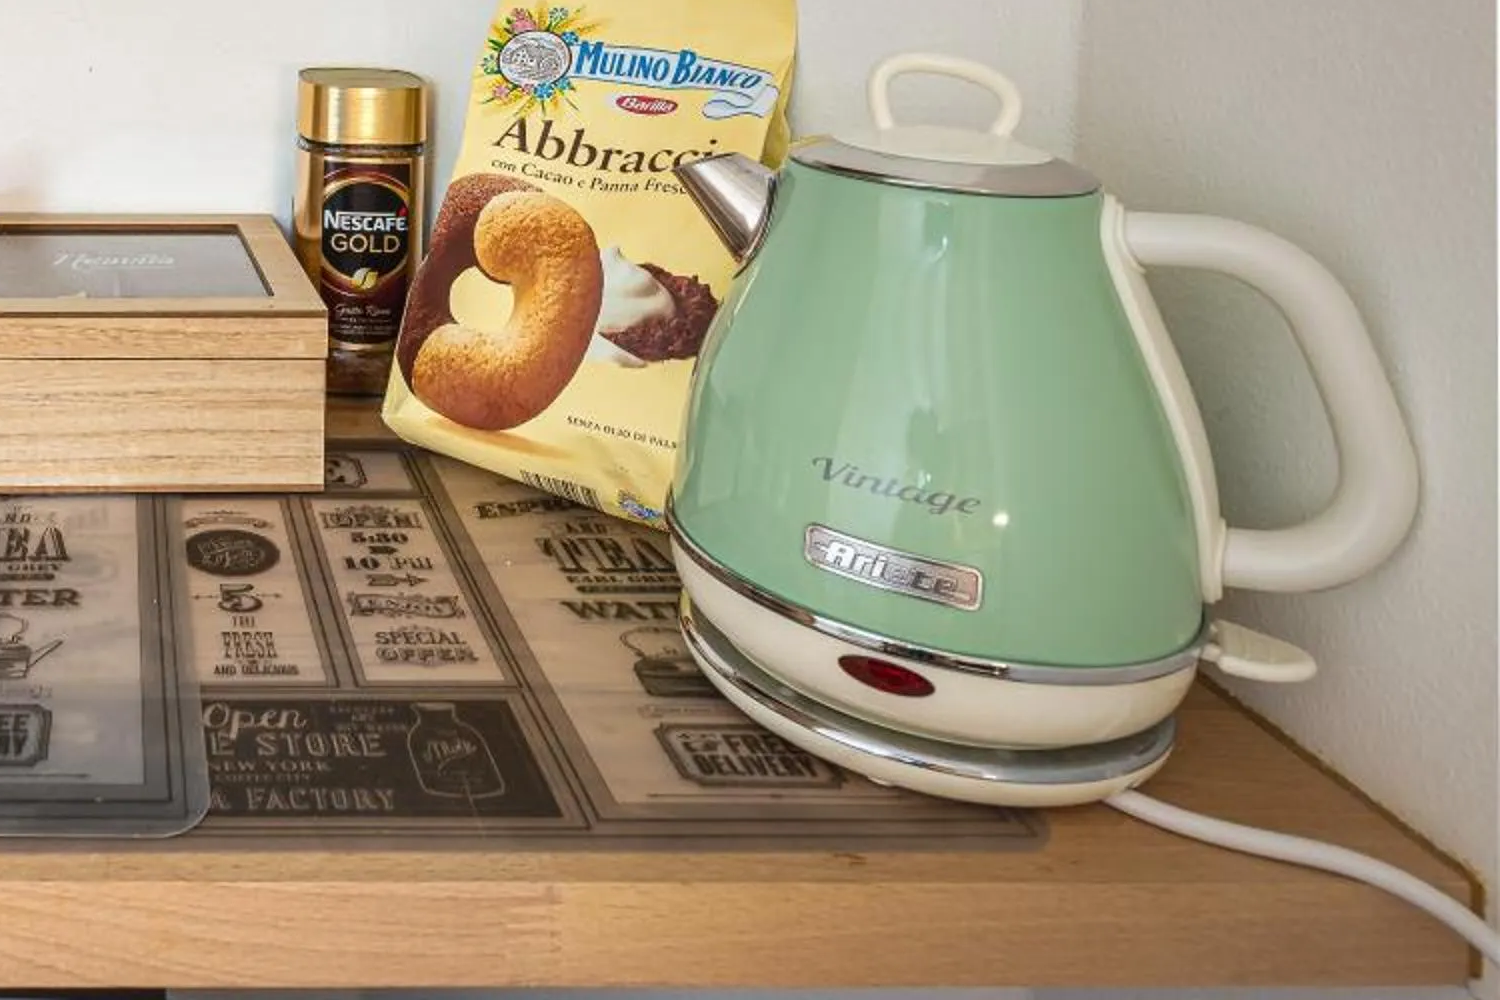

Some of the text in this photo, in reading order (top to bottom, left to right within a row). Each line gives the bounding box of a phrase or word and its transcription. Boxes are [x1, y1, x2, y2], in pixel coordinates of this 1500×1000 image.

[575, 40, 764, 89] MULINO BIANCO
[621, 97, 674, 114] Barilla
[491, 157, 687, 196] con Cacao e Panna Fresc
[330, 233, 401, 254] GOLD
[812, 456, 982, 515] Vintage
[344, 556, 380, 570] 10
[627, 575, 681, 583] GRE
[218, 583, 263, 613] 5
[560, 600, 680, 620] WAT
[375, 631, 468, 645] SPECIAL
[202, 702, 308, 740] Open
[256, 732, 388, 757] STORE
[209, 760, 333, 772] NEW YORK
[691, 755, 818, 777] DELIVERY
[247, 787, 395, 811] FACTORY
